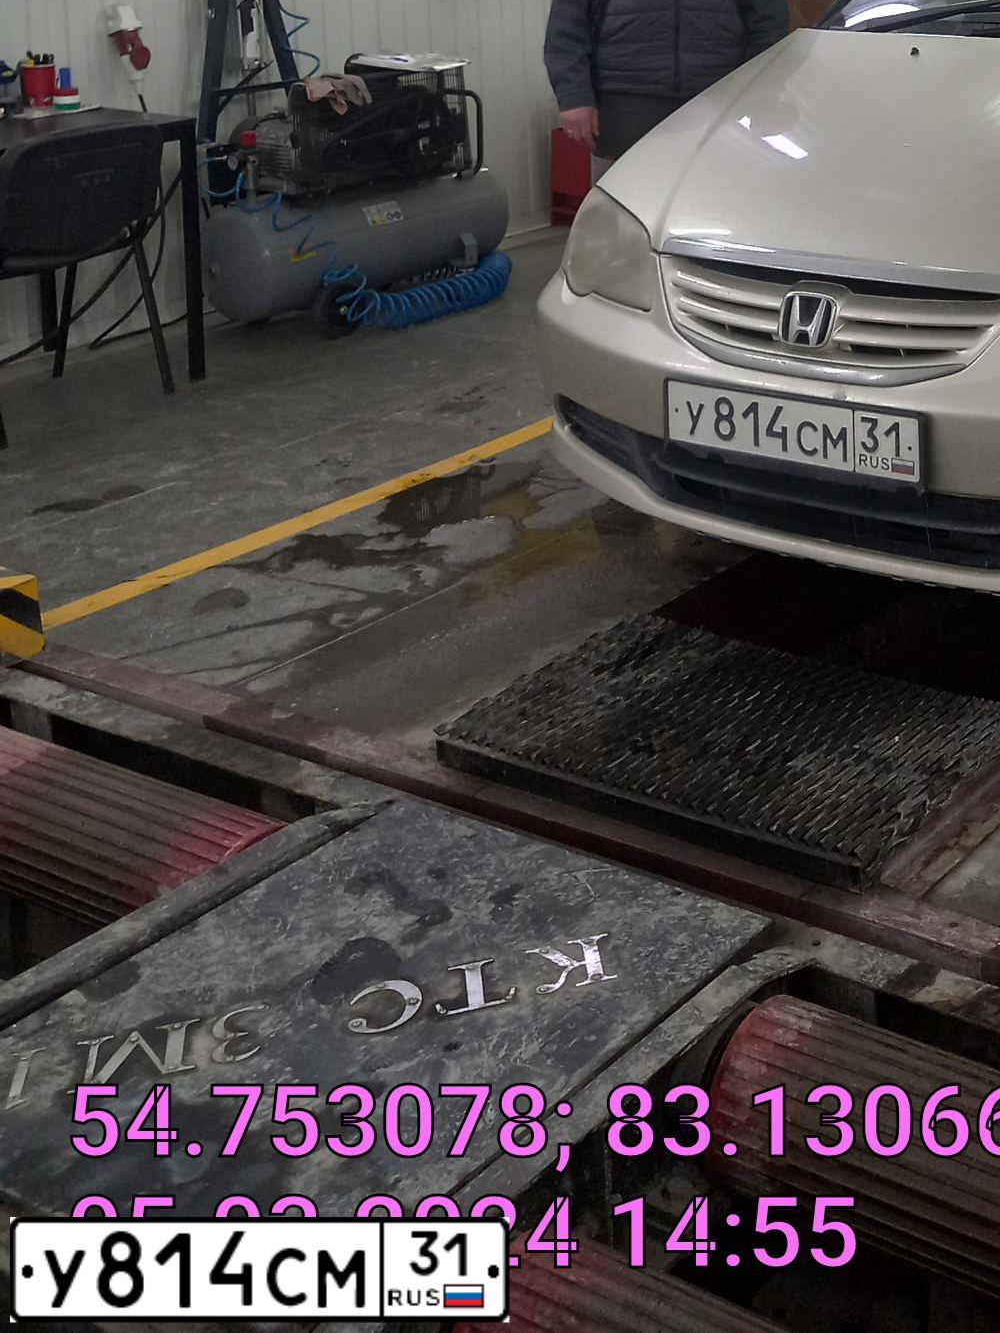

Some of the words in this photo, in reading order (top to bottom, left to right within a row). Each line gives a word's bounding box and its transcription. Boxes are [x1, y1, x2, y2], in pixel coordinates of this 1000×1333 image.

[686, 396, 848, 463] У814СМ
[860, 416, 901, 458] 31
[858, 453, 890, 471] RUS
